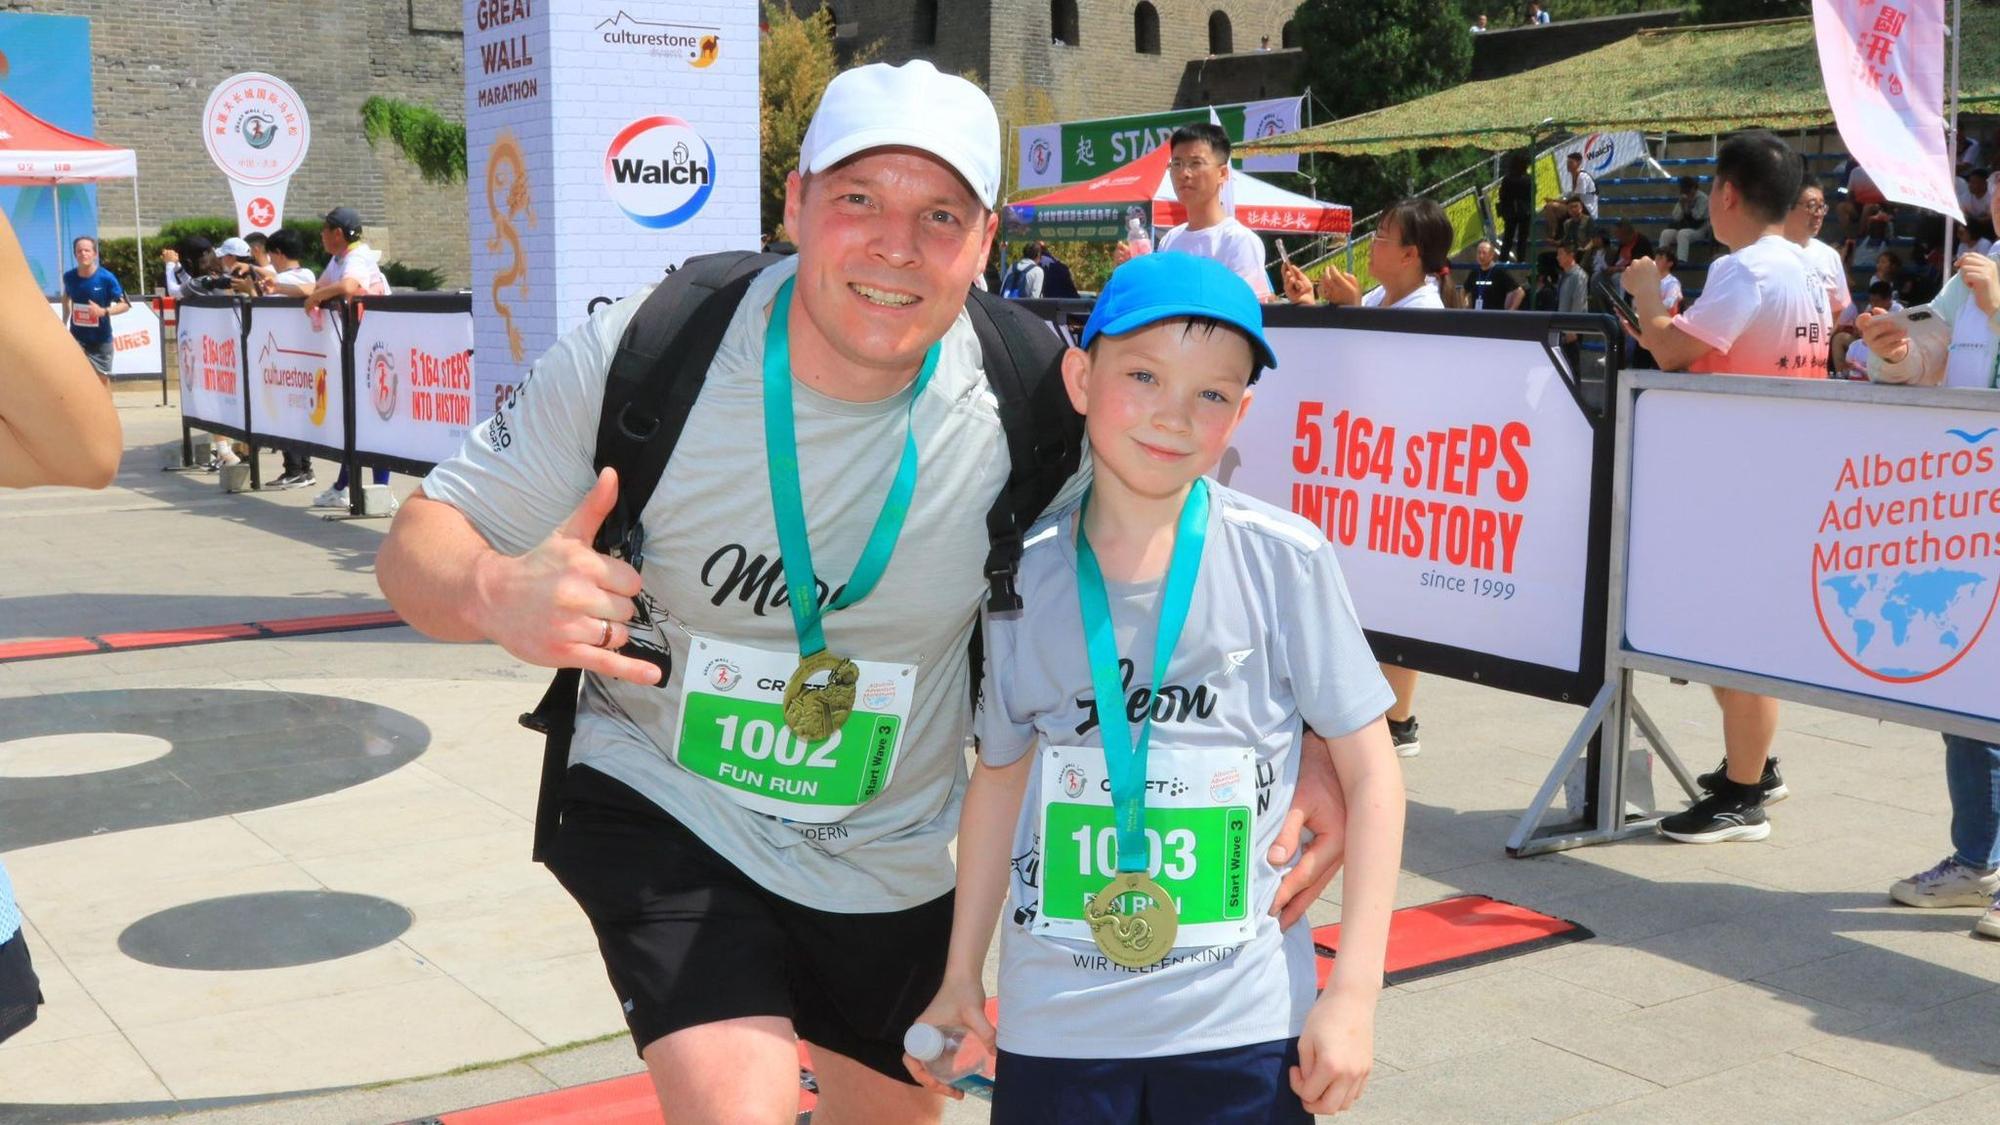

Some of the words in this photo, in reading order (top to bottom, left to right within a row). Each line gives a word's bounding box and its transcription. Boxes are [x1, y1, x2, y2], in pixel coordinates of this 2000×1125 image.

[480, 35, 533, 75] WALL
[603, 29, 697, 48] culturestone
[478, 78, 538, 108] MARATHON
[1075, 135, 1096, 167] 起
[1110, 126, 1187, 163] STA
[611, 156, 709, 186] Walch
[263, 362, 314, 390] culturestone
[410, 347, 440, 388] 5.164
[441, 349, 471, 391] STEPS
[412, 391, 433, 421] INTO
[435, 392, 471, 427] HISTORY
[1291, 400, 1396, 485] 5.164
[1403, 420, 1532, 503] STEPS
[1834, 446, 1994, 492] Albatros
[1818, 487, 2000, 534] Adventure
[1291, 482, 1359, 547] INTO
[1367, 492, 1524, 575] HISTORY
[1420, 568, 1466, 593] since
[1473, 577, 1516, 601] 1999
[715, 714, 842, 768] 1002
[878, 725, 891, 735] 3
[872, 738, 888, 766] Wave
[718, 762, 764, 788] FUN
[769, 776, 819, 797] RUN
[865, 767, 880, 796] Start
[1100, 778, 1169, 793] CFT
[1231, 819, 1244, 831] 3
[1230, 834, 1243, 872] Wave
[1228, 874, 1240, 908] Start
[1073, 953, 1108, 971] WIR
